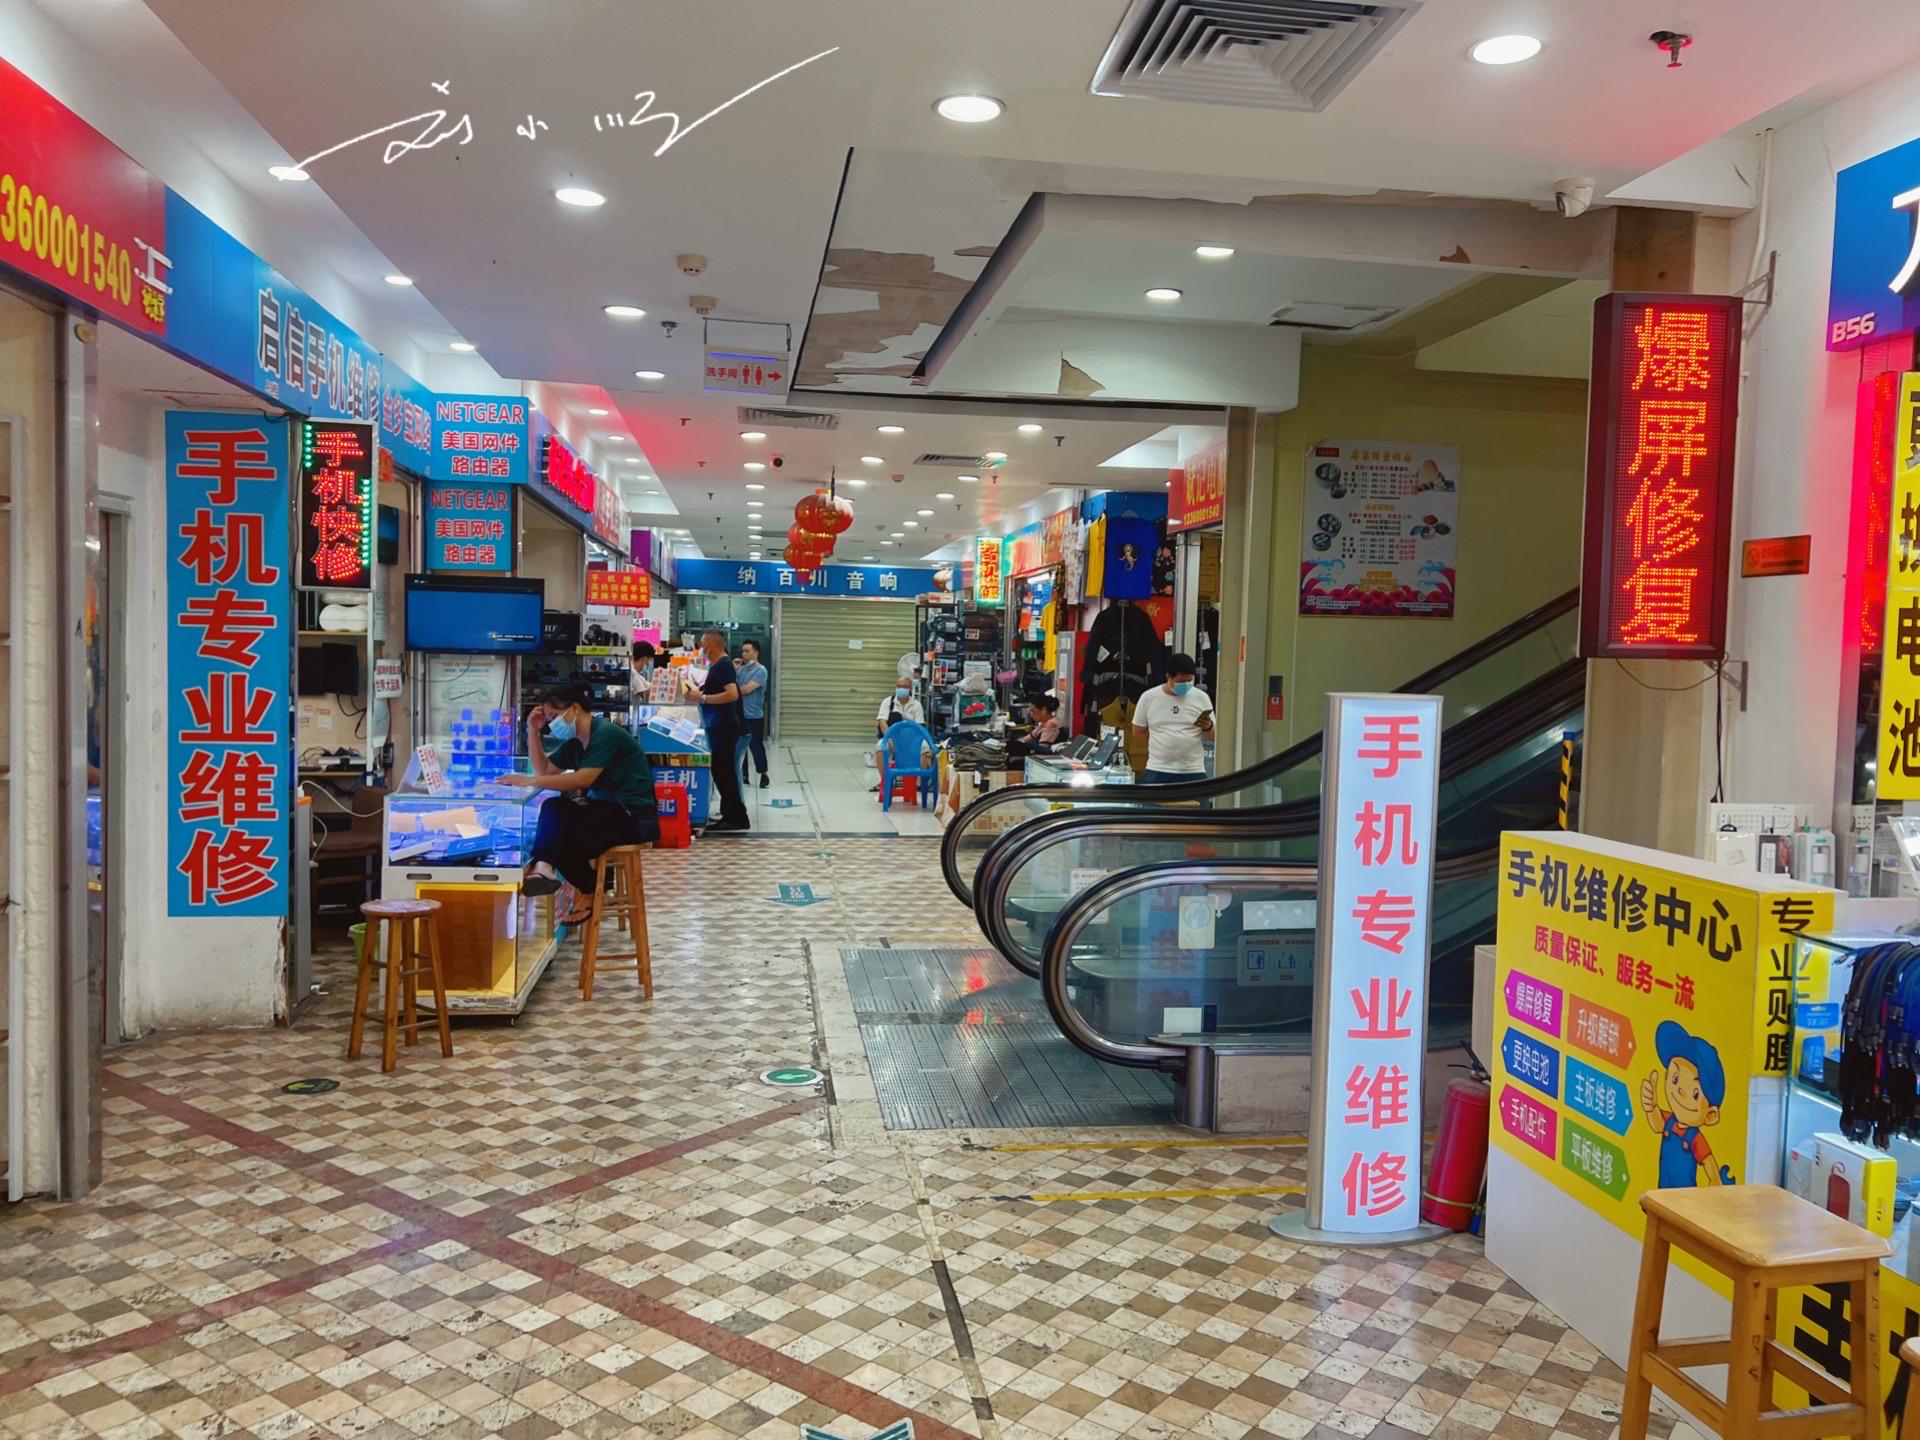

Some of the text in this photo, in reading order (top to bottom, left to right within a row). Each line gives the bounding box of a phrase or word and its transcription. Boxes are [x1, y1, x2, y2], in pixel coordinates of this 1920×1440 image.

[1831, 312, 1875, 344] B56
[706, 366, 738, 379] 洗手间
[436, 401, 525, 425] NETGEAR
[442, 431, 520, 453] 美国网件
[451, 456, 510, 477] 路由器
[1620, 308, 1710, 644] 爆屏修复
[311, 430, 364, 580] 手机快修
[431, 489, 509, 511] NETGEAR
[435, 519, 504, 539] 美国网件
[444, 543, 497, 565] 路由器
[738, 566, 898, 593] 纳百川音响
[177, 429, 278, 908] 手机专业维修
[1507, 849, 1743, 963] 手机维修中心
[1341, 715, 1423, 1217] 手机专业维修
[1534, 924, 1696, 1011] 质量保证、服务一流
[1514, 980, 1554, 1027] 爆屏修复
[1576, 1007, 1620, 1058] 升级解锁
[1512, 1038, 1550, 1085] 更换电池
[1573, 1070, 1617, 1122] 主板维修
[1510, 1097, 1547, 1145] 手机配件
[1570, 1130, 1615, 1186] 平板维修
